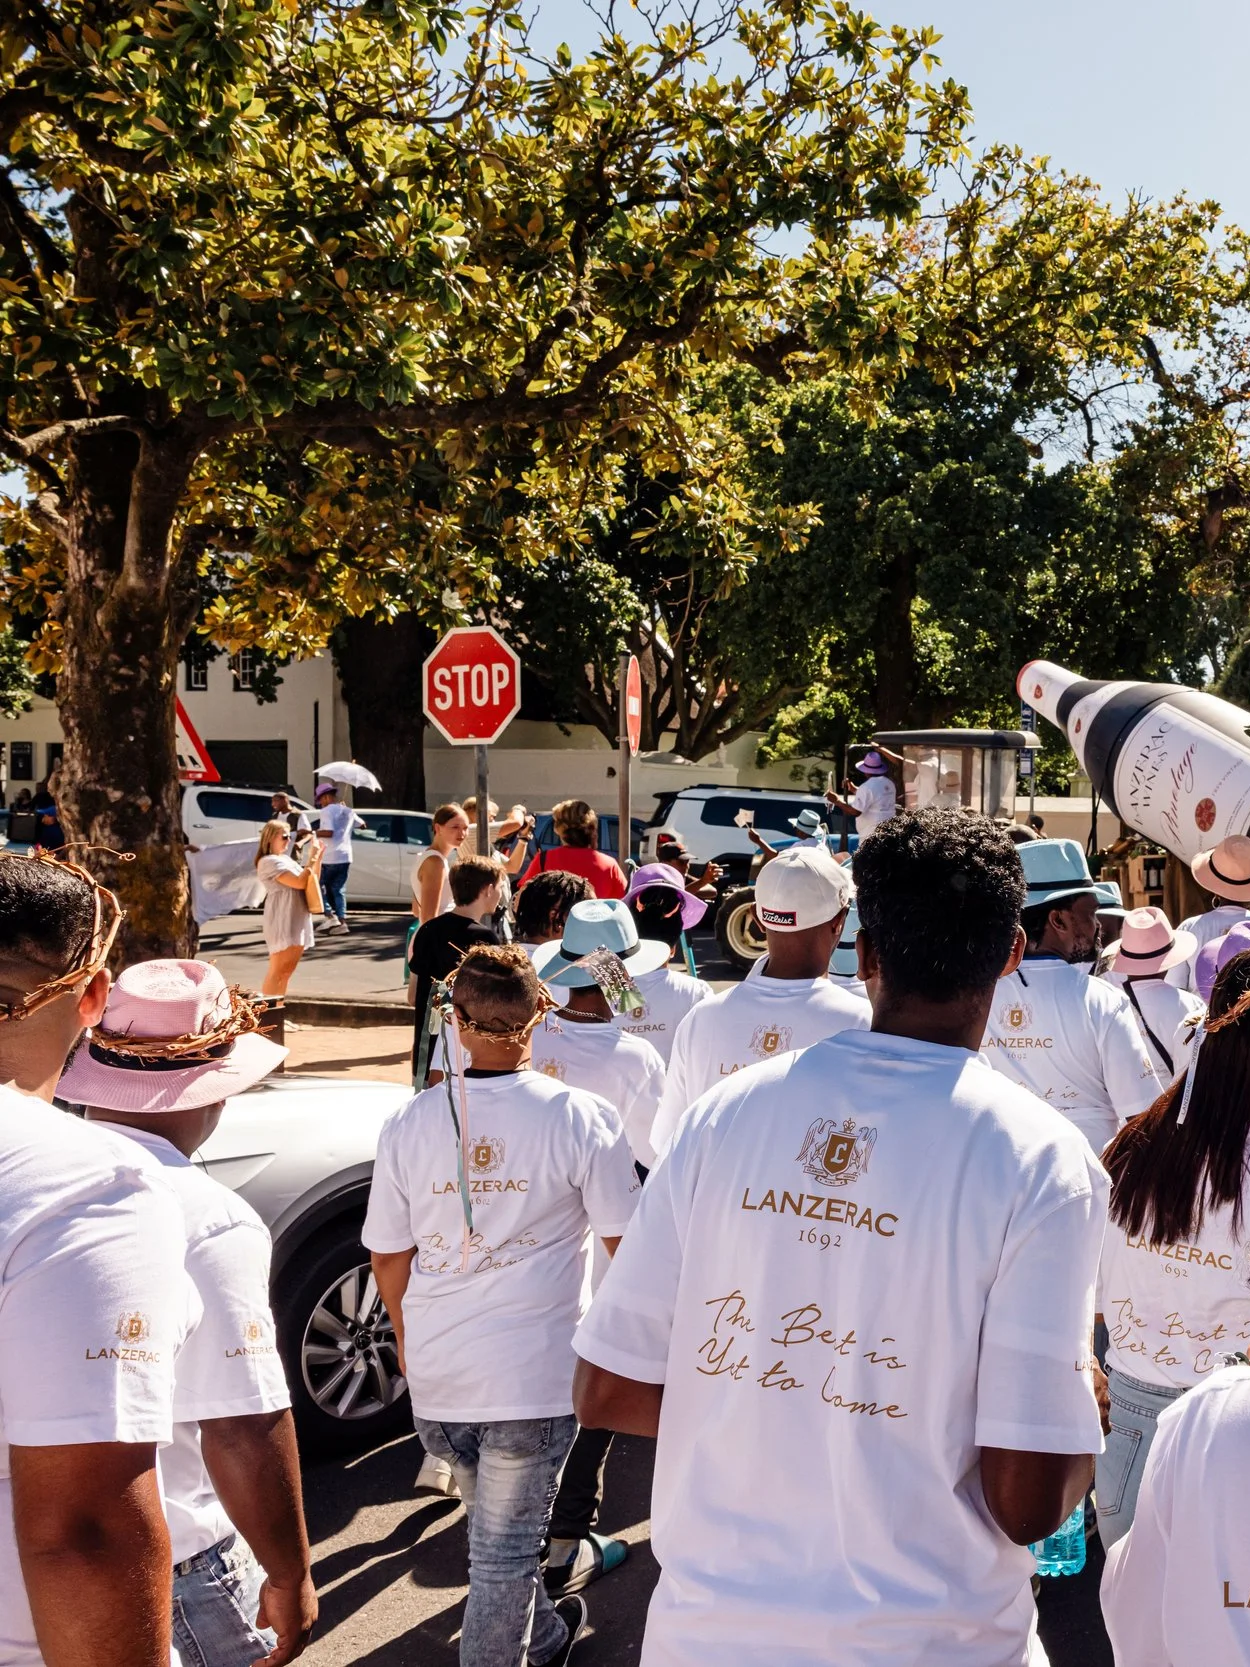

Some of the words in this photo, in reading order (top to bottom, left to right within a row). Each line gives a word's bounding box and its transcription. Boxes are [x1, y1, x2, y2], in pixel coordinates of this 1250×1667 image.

[433, 663, 510, 710] STOP
[1130, 721, 1174, 826] LANZERAC
[1143, 751, 1168, 807] WINES
[763, 911, 794, 924] Titleist
[616, 1023, 666, 1034] NZERAC
[980, 1038, 1053, 1049] LANZERAC
[741, 1188, 899, 1237] LANZERAC
[798, 1227, 841, 1250] 1692
[1126, 1234, 1233, 1271] LANZERAC
[706, 1290, 755, 1333] The
[771, 1303, 856, 1354] Bet
[864, 1338, 906, 1369] is
[1112, 1298, 1148, 1328] The
[1160, 1312, 1227, 1341] Best
[86, 1348, 161, 1363] LANZERAC
[225, 1347, 274, 1358] LANZERAC
[696, 1337, 749, 1380] Yet
[757, 1360, 804, 1390] to
[1110, 1325, 1148, 1356] Yet
[1153, 1346, 1182, 1366] to
